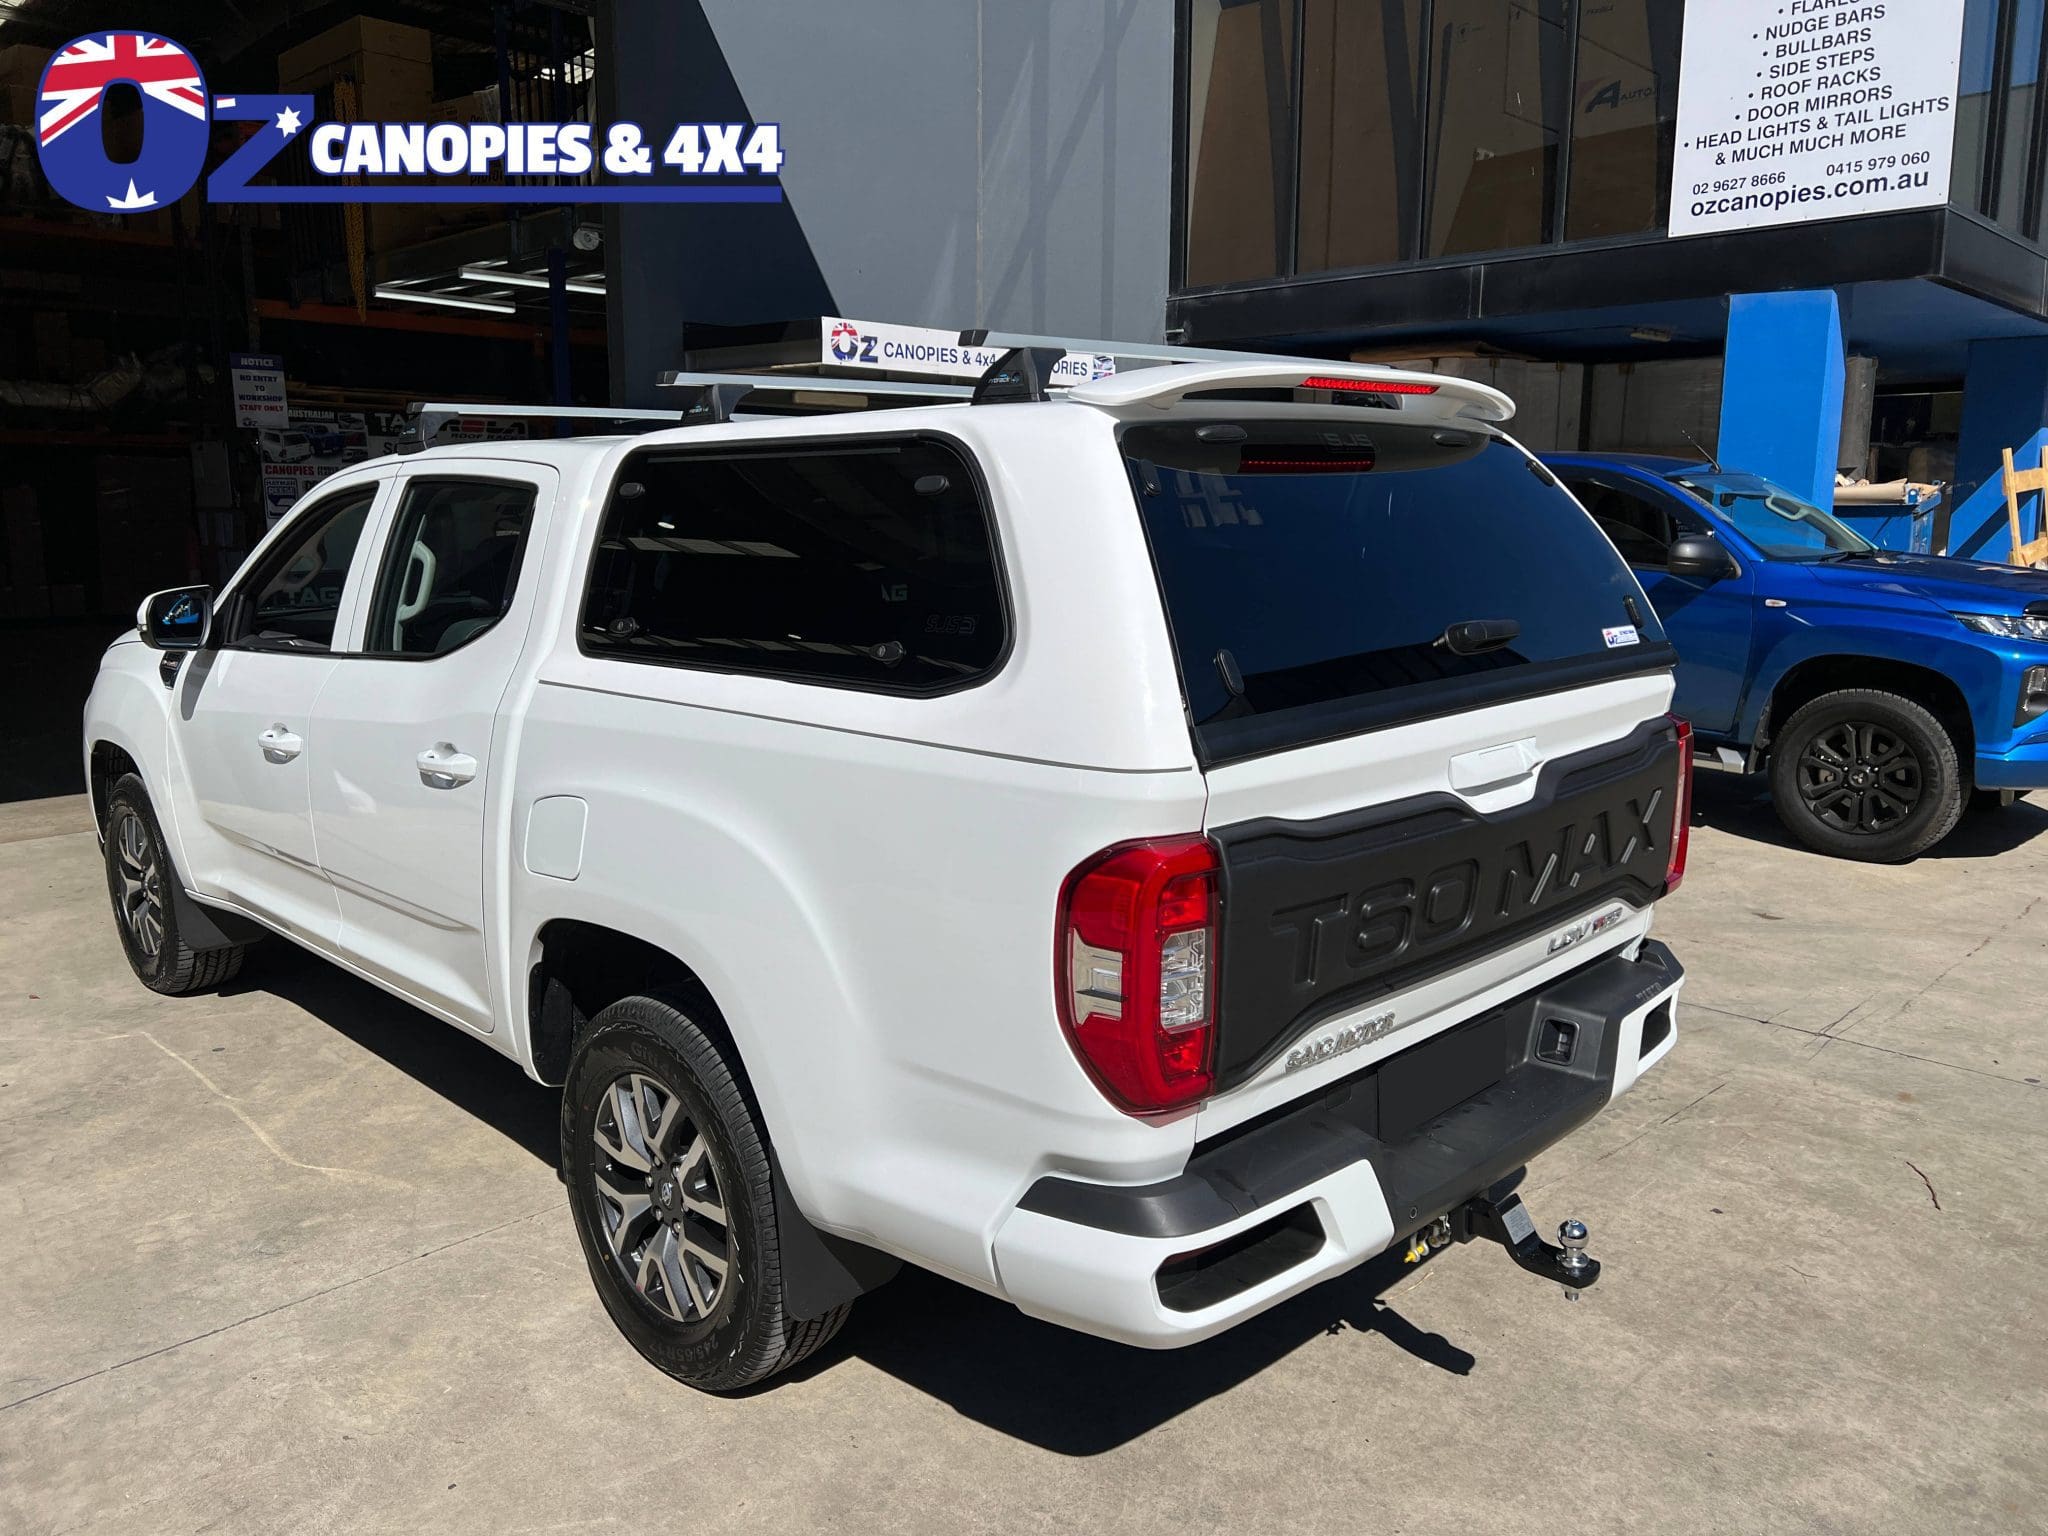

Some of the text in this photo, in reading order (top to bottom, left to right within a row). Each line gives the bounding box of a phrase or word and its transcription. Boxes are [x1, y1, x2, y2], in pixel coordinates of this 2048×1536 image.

[1765, 4, 1885, 41] NUDGE BARS
[1791, 0, 1860, 16] FLAR
[1775, 27, 1872, 59] BULLBARS
[1769, 47, 1875, 79] SIDE STEPS
[1761, 66, 1881, 101] ROOF RACKS
[1747, 84, 1893, 122] DOOR MIRRORS
[1696, 96, 1949, 150] HEAD LIGHTS & TAIL LIGHTS
[1715, 123, 1907, 166] & MUCH MUCH MORE
[1826, 150, 1930, 177] 0415 979 060
[1690, 171, 1929, 217] ozcanopies.com.au
[1692, 171, 1786, 196] 02 9627 8666
[240, 356, 275, 367] NOTICE
[884, 341, 959, 365] CANOPIES
[962, 349, 972, 365] &
[975, 351, 997, 367] 4x4
[253, 374, 278, 383] ENTRY
[238, 394, 284, 402] WORKSHOP
[239, 404, 285, 412] STAFF ONLY
[264, 465, 315, 476] CANOPIES
[1270, 788, 1662, 986] T60 MAX
